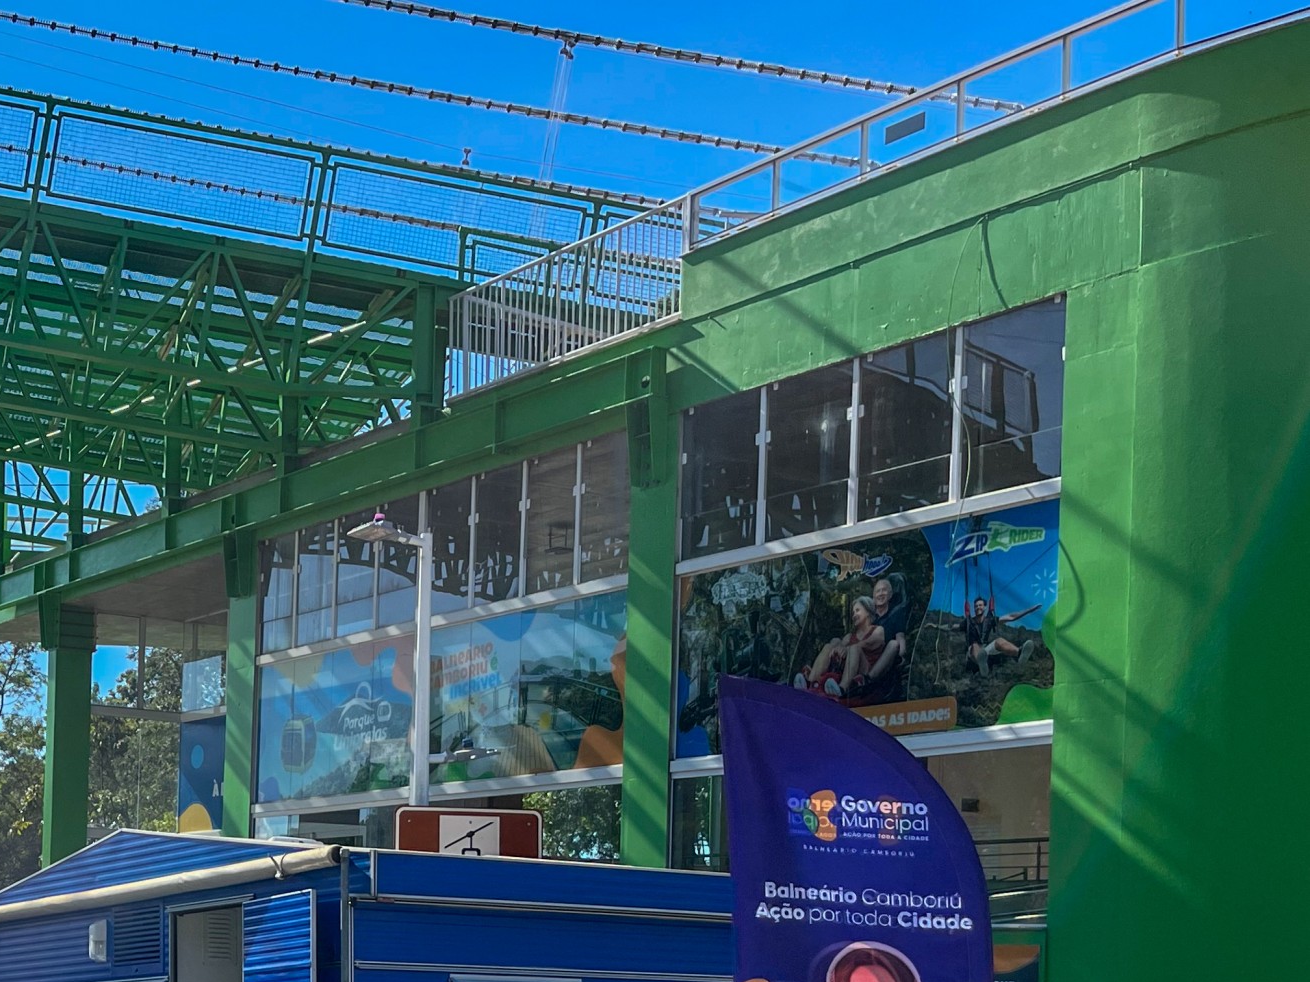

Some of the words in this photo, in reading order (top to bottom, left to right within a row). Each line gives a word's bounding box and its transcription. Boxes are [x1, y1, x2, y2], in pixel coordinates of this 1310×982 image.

[1009, 528, 1044, 545] RIDER
[343, 714, 375, 733] Parque
[888, 712, 904, 726] AS
[841, 795, 928, 815] Governo
[842, 811, 929, 833] Municipal
[765, 882, 857, 904] Balneário
[861, 888, 962, 910] Camboriú
[755, 902, 805, 923] Ação
[809, 908, 841, 925] por
[845, 908, 892, 927] toda
[897, 911, 973, 930] Cidade
